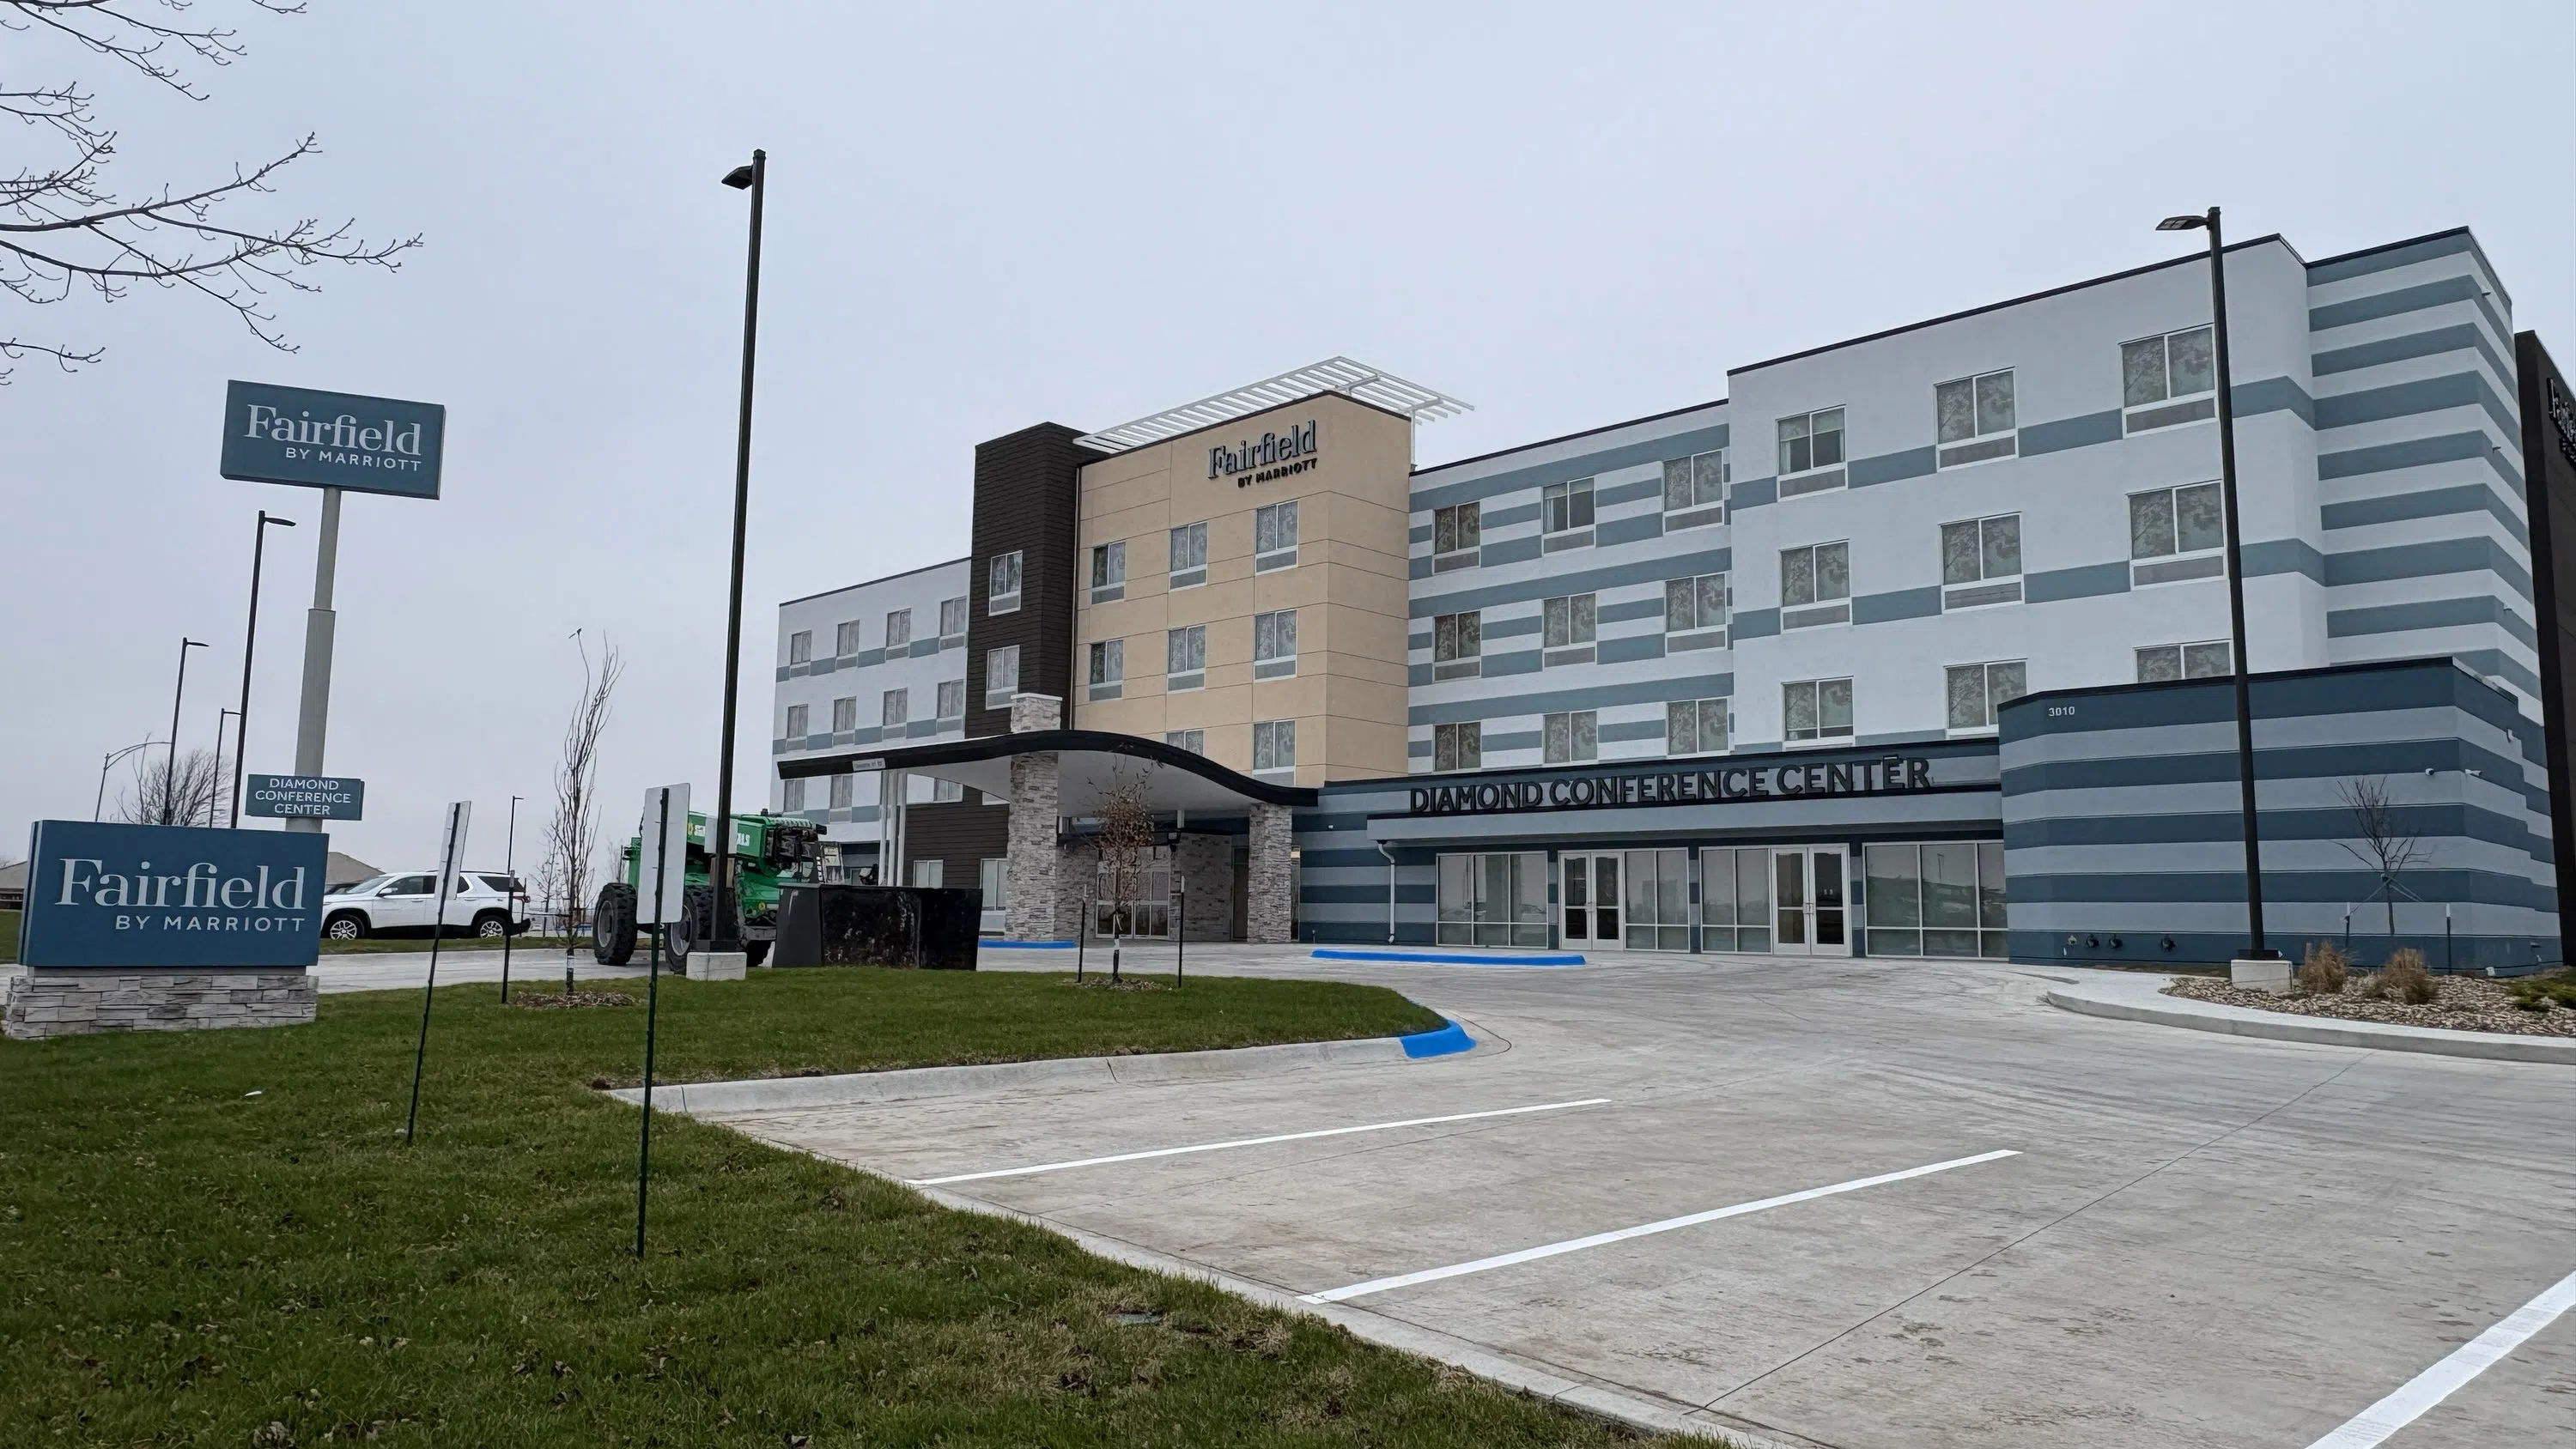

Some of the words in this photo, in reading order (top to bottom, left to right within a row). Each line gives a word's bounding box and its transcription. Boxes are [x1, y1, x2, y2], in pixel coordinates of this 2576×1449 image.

[244, 403, 422, 456] Fairfield
[286, 447, 311, 459] BY
[319, 451, 422, 471] MARRIOTT
[1207, 419, 1317, 480] Fairfield
[1237, 475, 1253, 488] BY
[1255, 458, 1318, 483] MARRIOTT
[2048, 706, 2075, 717] 3010
[255, 790, 351, 803] CONFERENCE
[269, 778, 339, 791] DIAMOND
[1410, 781, 1543, 812] DIAMOND
[1549, 767, 1769, 807] CONFERENCE
[1777, 757, 1931, 795] CENTER
[274, 803, 331, 815] CENTER
[54, 858, 307, 910] Fairfield
[115, 915, 150, 930] BY
[163, 916, 305, 931] MARRIOTT
